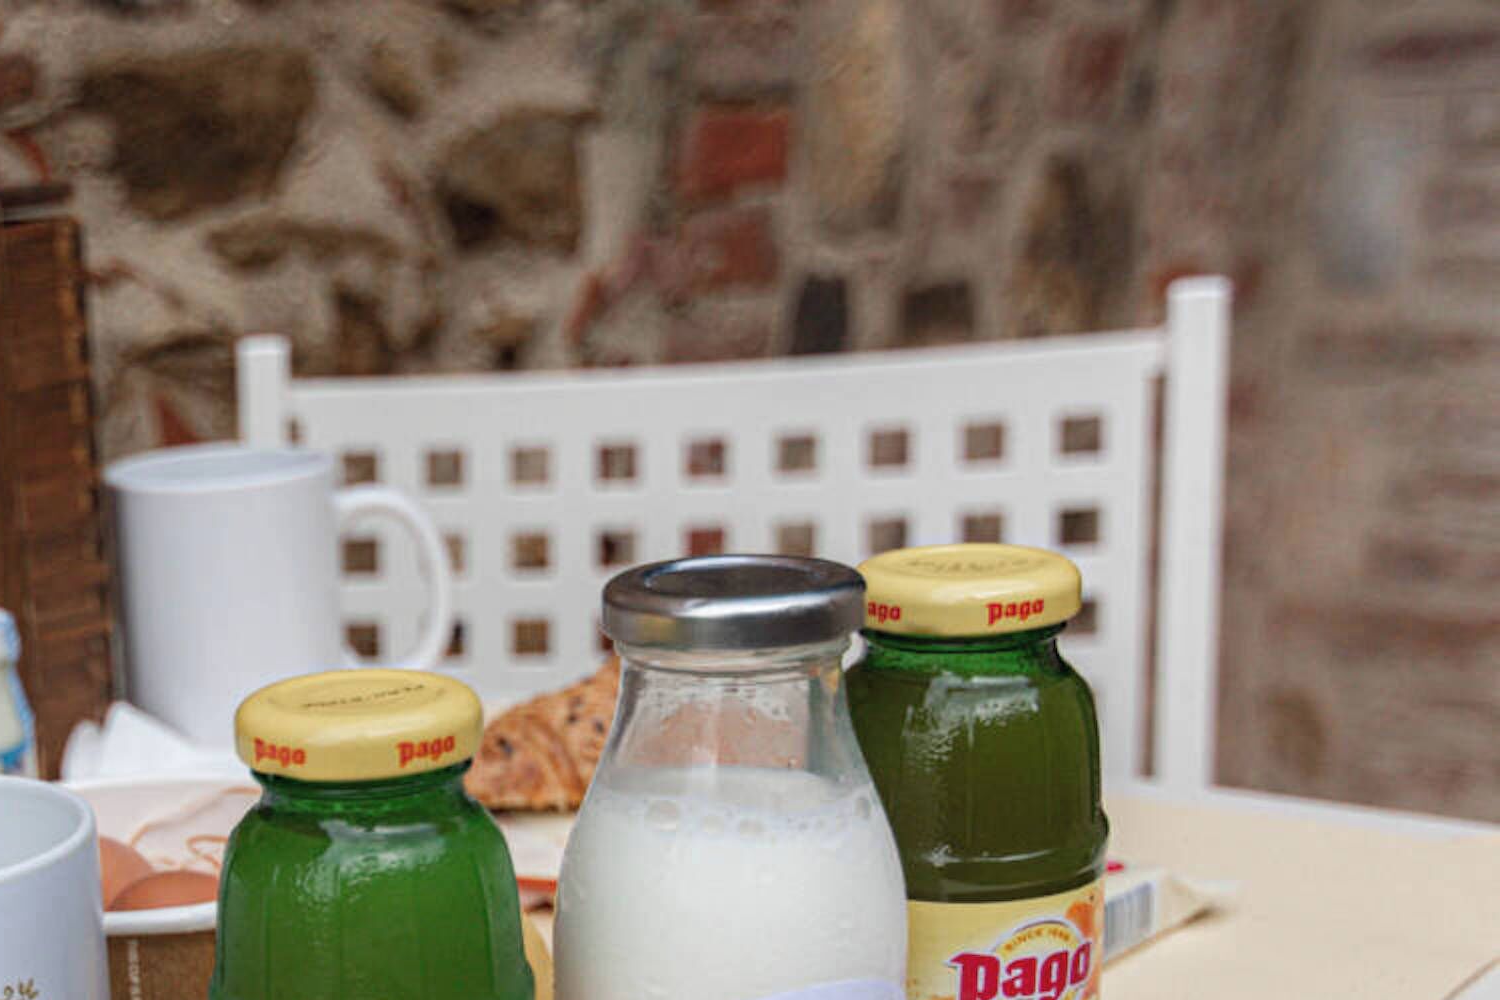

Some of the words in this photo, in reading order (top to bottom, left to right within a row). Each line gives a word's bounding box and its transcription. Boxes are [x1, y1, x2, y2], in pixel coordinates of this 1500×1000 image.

[867, 600, 901, 623] ago
[985, 599, 1044, 624] pago
[253, 737, 306, 766] pago
[397, 735, 454, 768] pago
[128, 963, 141, 982] CUP
